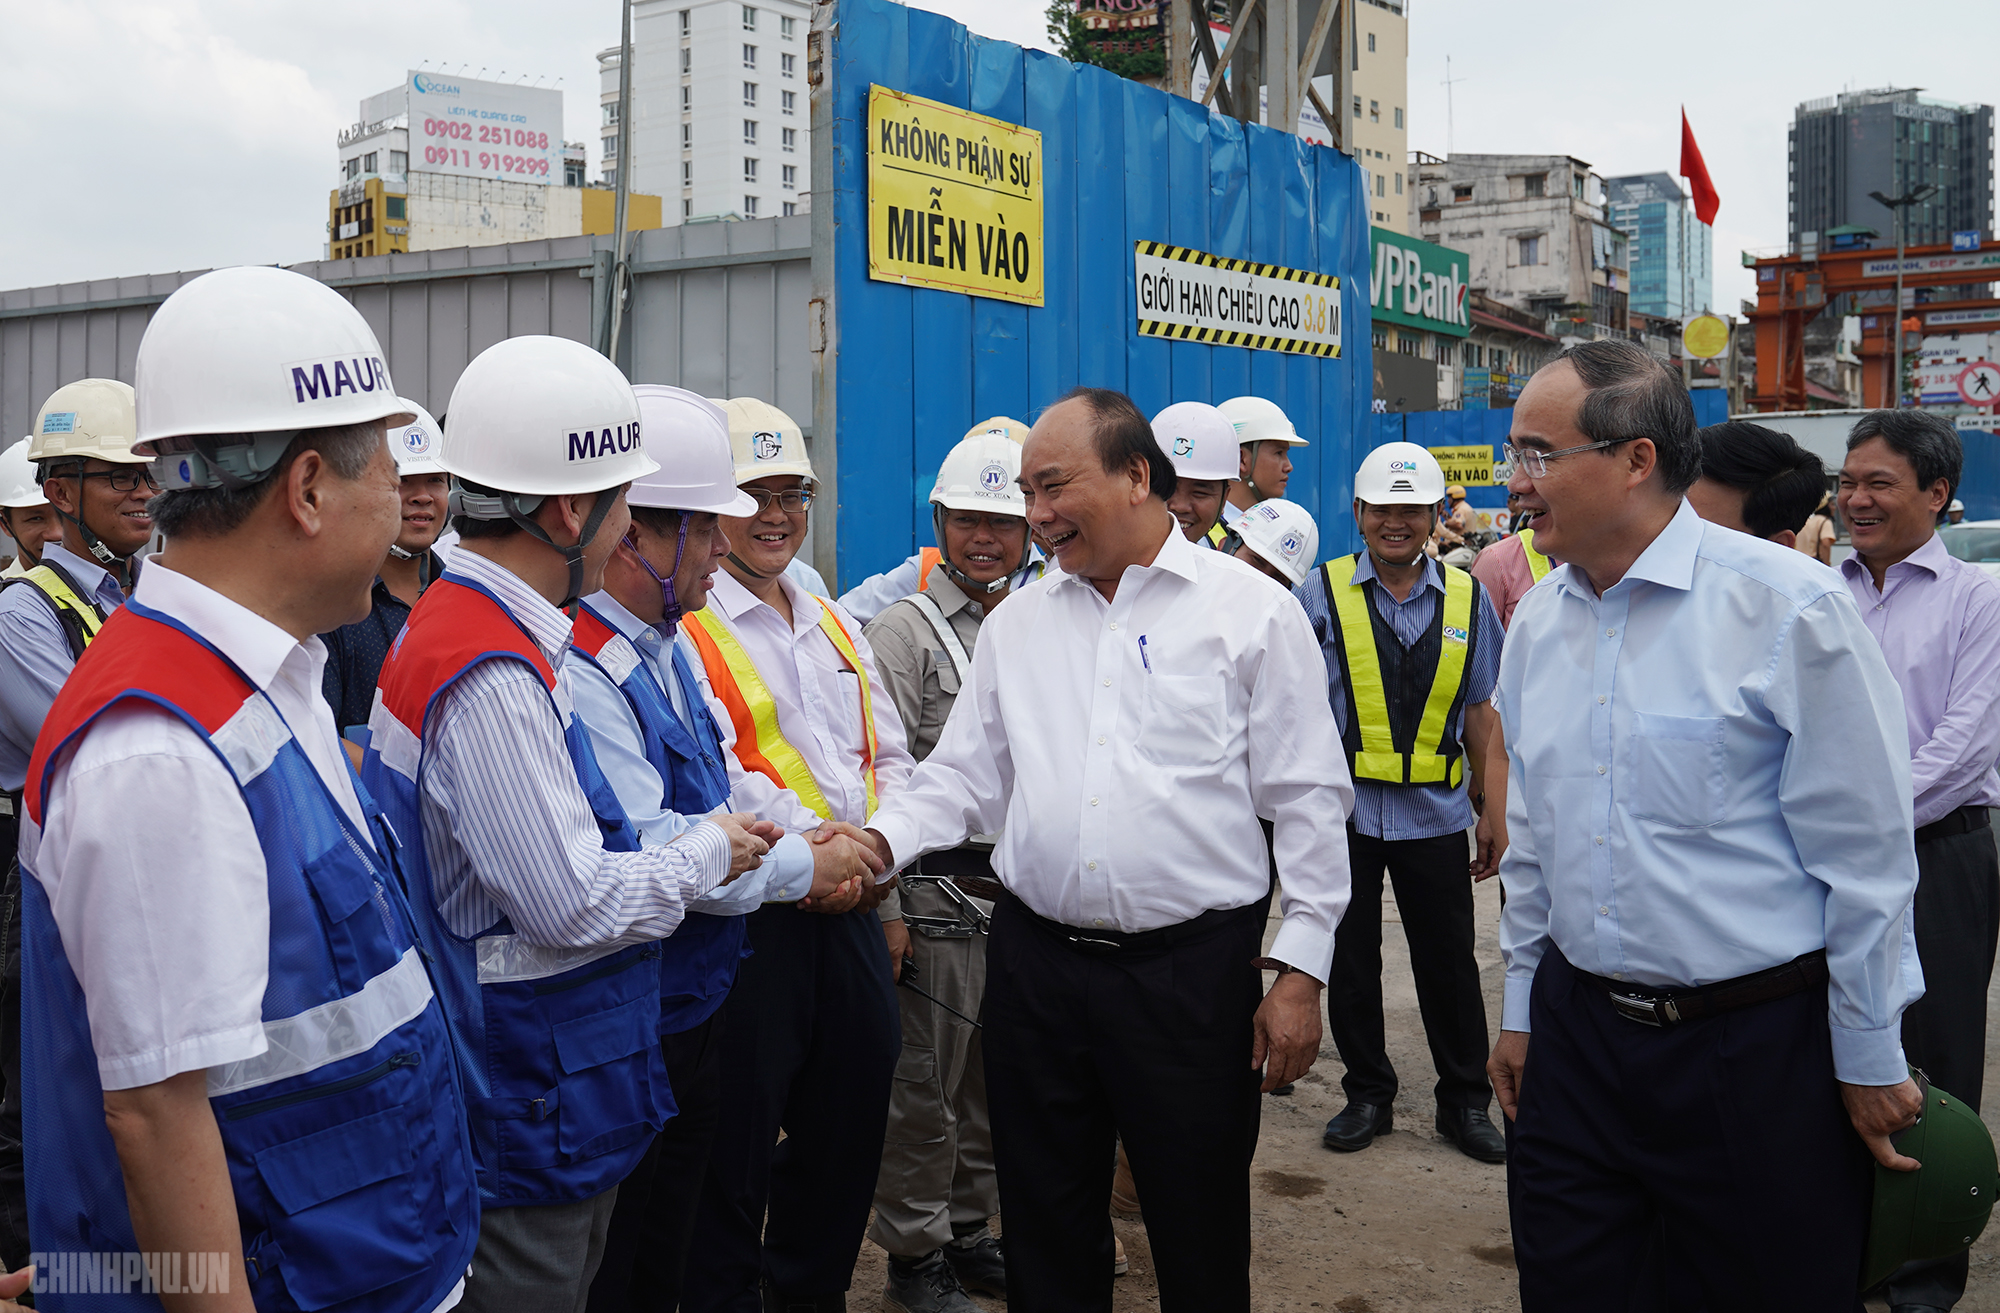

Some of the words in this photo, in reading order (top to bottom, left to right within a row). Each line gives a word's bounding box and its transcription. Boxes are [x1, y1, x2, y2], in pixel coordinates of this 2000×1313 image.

[426, 82, 461, 95] OCEAN
[424, 118, 473, 141] 0902
[478, 125, 549, 150] 251088
[424, 145, 470, 168] 0911
[478, 151, 549, 176] 919299
[881, 117, 950, 169] KHÔNG
[956, 135, 1005, 185] PHẬN
[1009, 150, 1032, 195] SỰ
[888, 186, 967, 272] MIỄN
[975, 213, 1030, 283] VÀO
[1972, 233, 1979, 245] 1
[1371, 242, 1468, 327] VPBank
[1141, 267, 1175, 313] GIỚI
[1180, 280, 1213, 324] HẠN
[1268, 294, 1300, 331] CAO
[1303, 293, 1326, 334] 3.8
[1329, 305, 1339, 336] M
[291, 357, 390, 404] MAUR
[568, 421, 642, 462] MAUR
[986, 472, 1001, 484] JV
[1465, 466, 1489, 481] VÀO
[1284, 538, 1299, 550] JV
